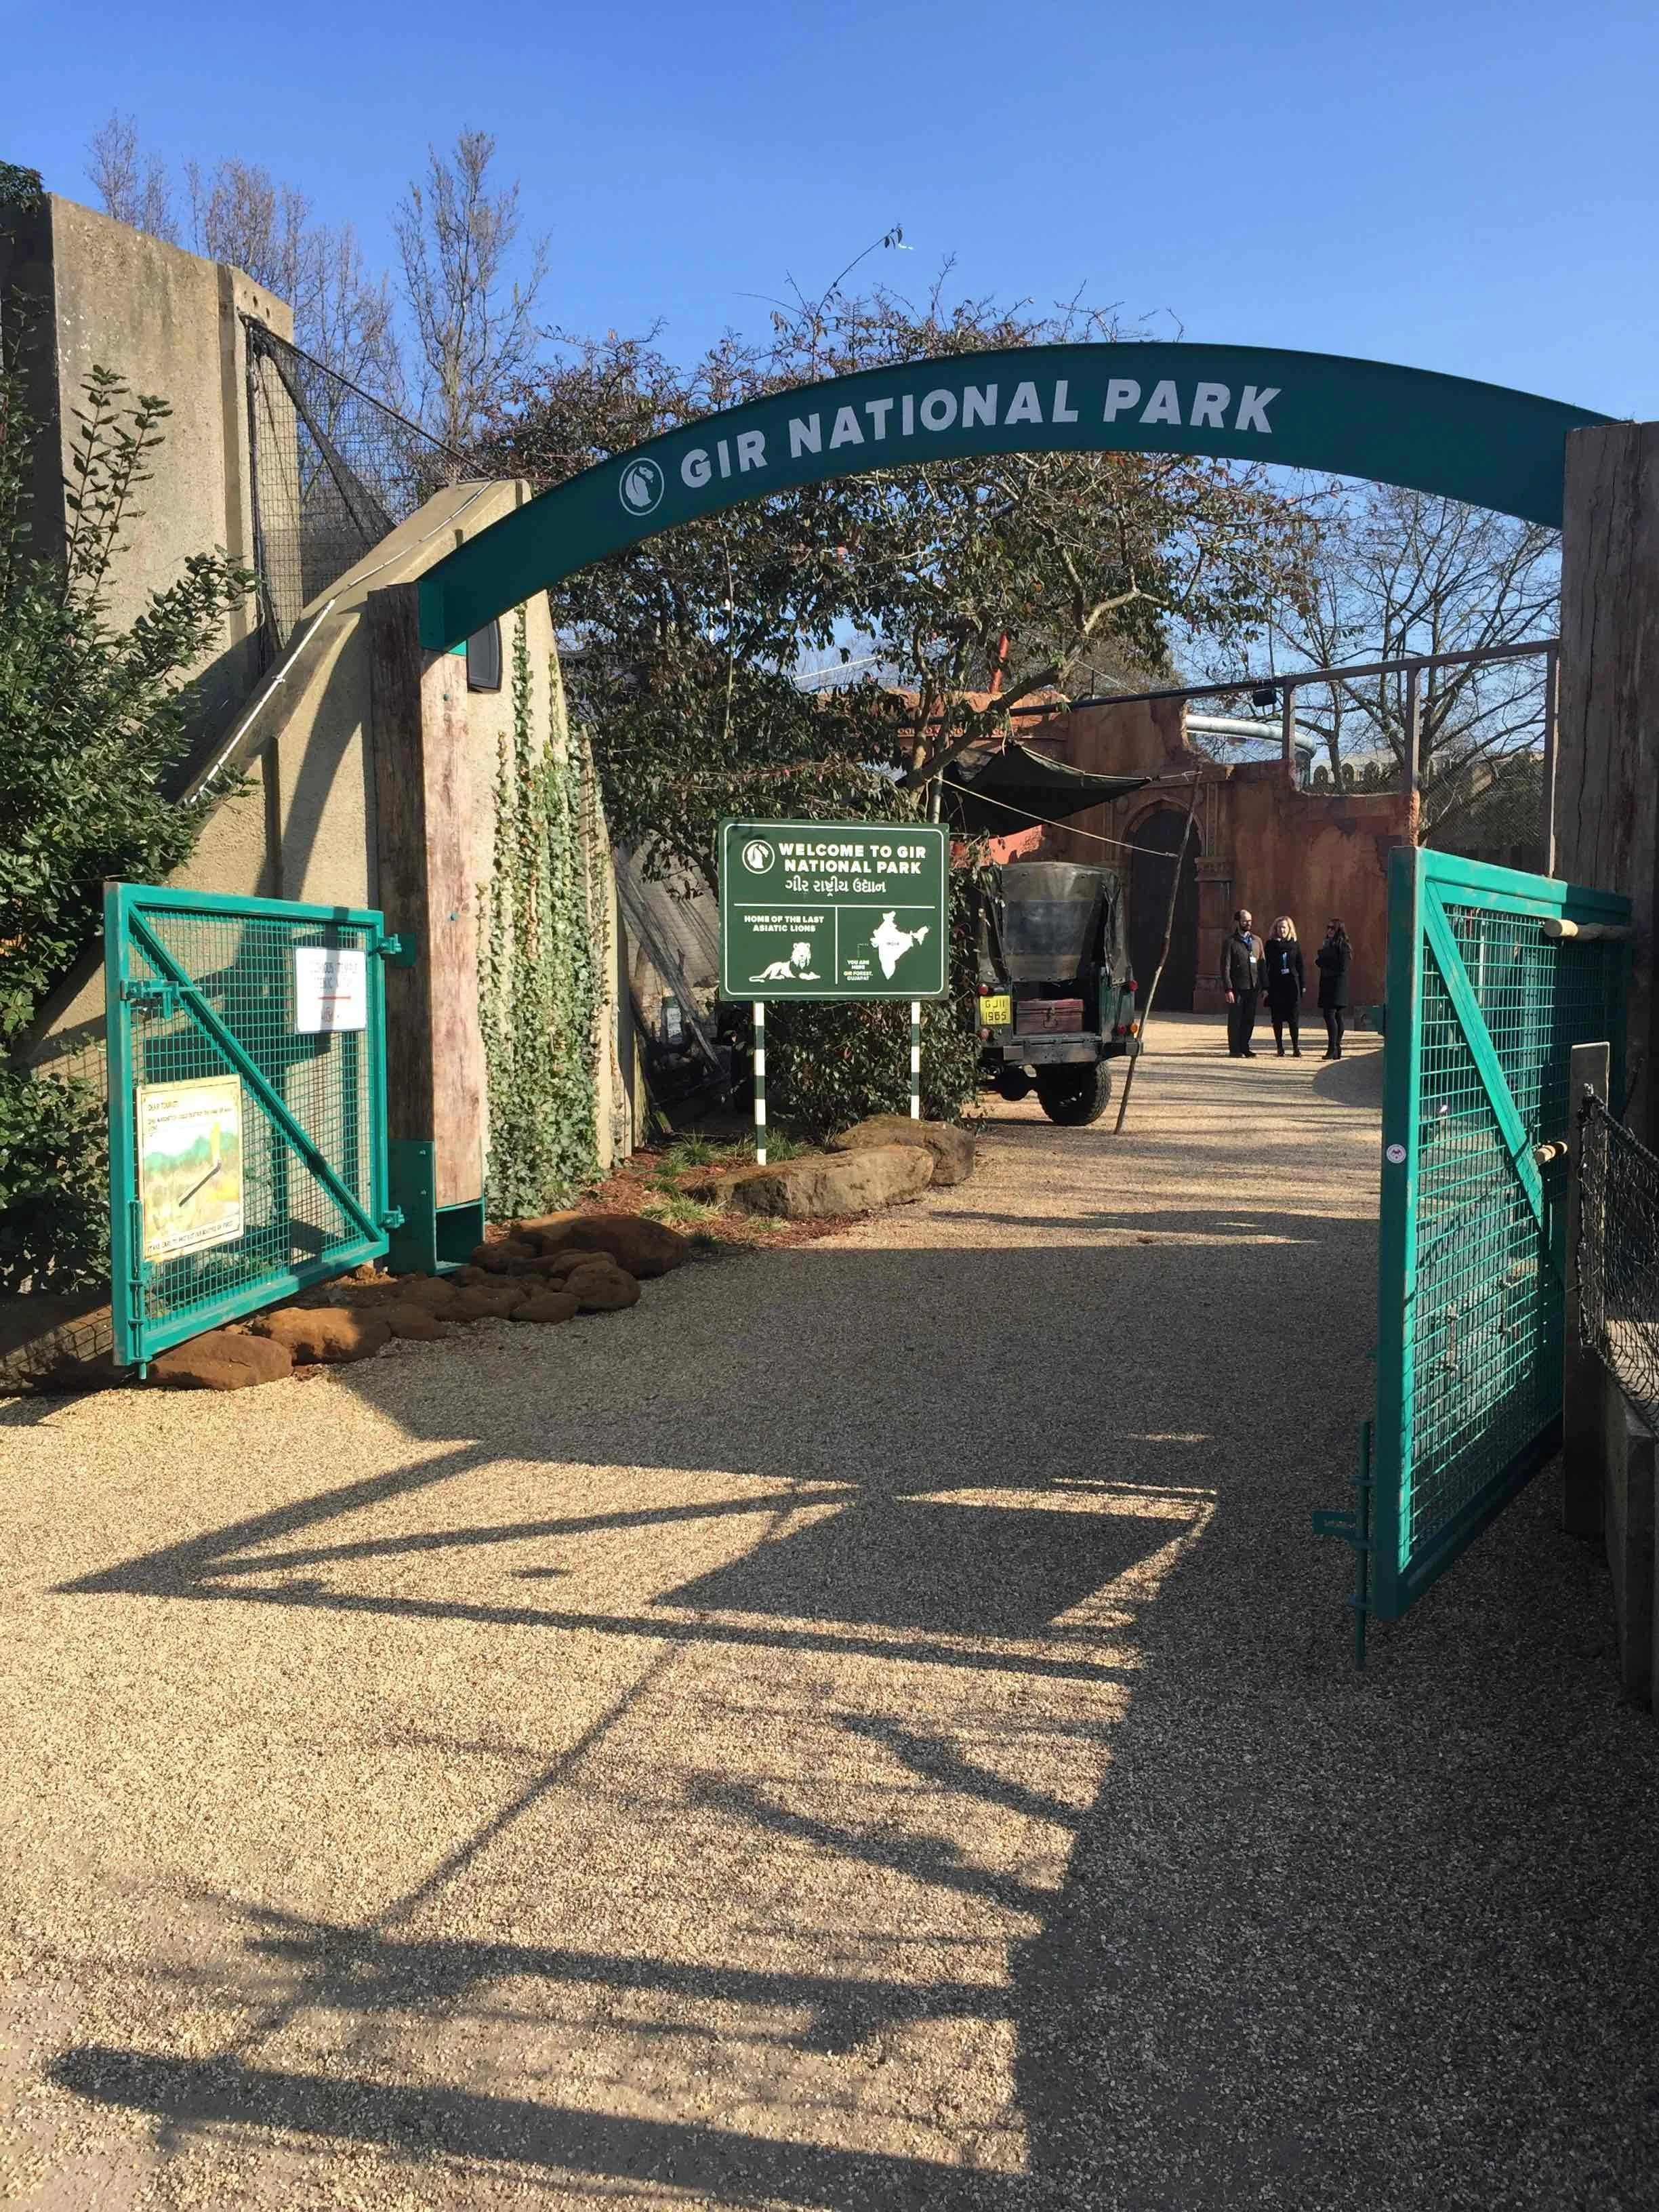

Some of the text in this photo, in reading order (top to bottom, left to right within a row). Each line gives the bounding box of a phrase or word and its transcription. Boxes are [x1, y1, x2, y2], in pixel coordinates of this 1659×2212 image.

[680, 379, 1282, 489] GIR NATIONAL PARK
[778, 843, 927, 859] WELCOME TO GIR
[784, 859, 922, 874] NATIONAL PARK
[985, 1011, 1007, 1021] 1965
